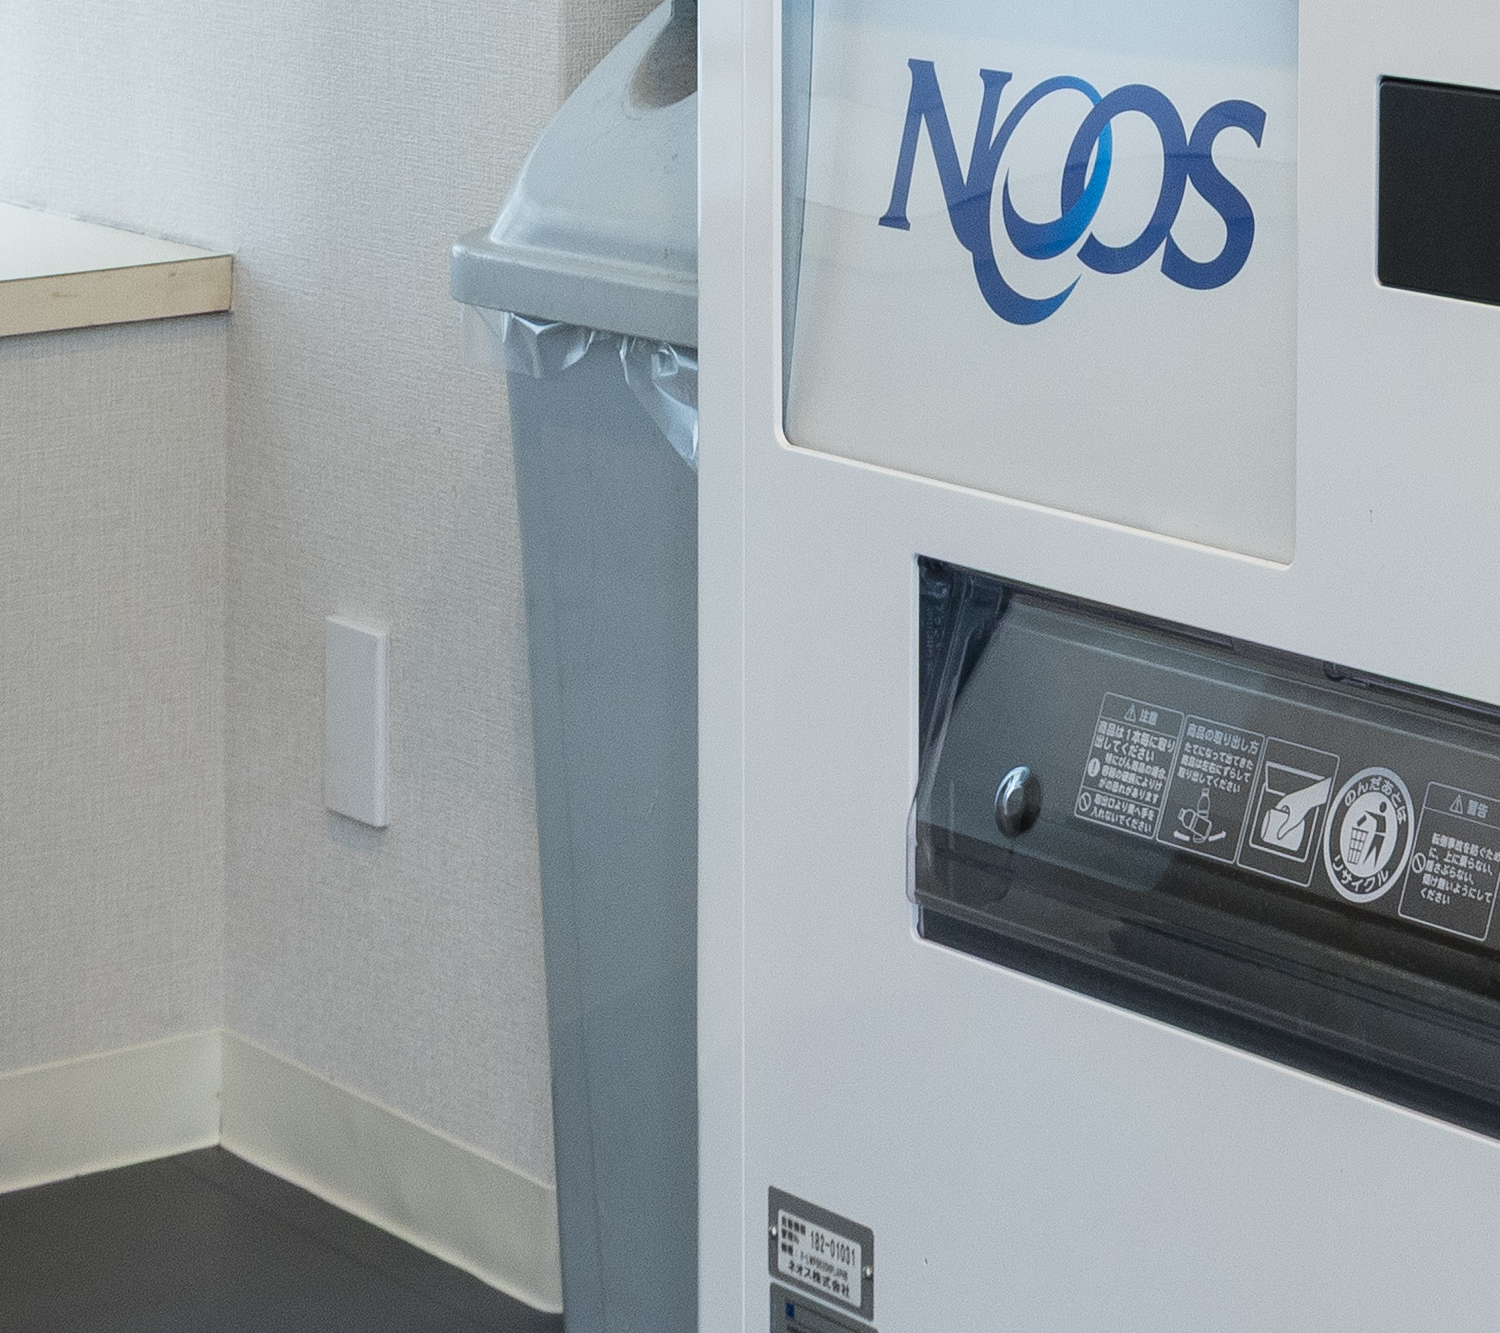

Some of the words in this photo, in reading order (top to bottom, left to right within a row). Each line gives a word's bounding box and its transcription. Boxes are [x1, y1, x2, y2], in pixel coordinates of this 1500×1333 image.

[1139, 708, 1159, 726] 注意
[1094, 735, 1155, 762] 出してください
[1186, 723, 1260, 755] 商品の取り出し方
[1344, 776, 1407, 825] のんだあとは
[1332, 853, 1389, 893] リサイクル
[1420, 887, 1451, 905] ください
